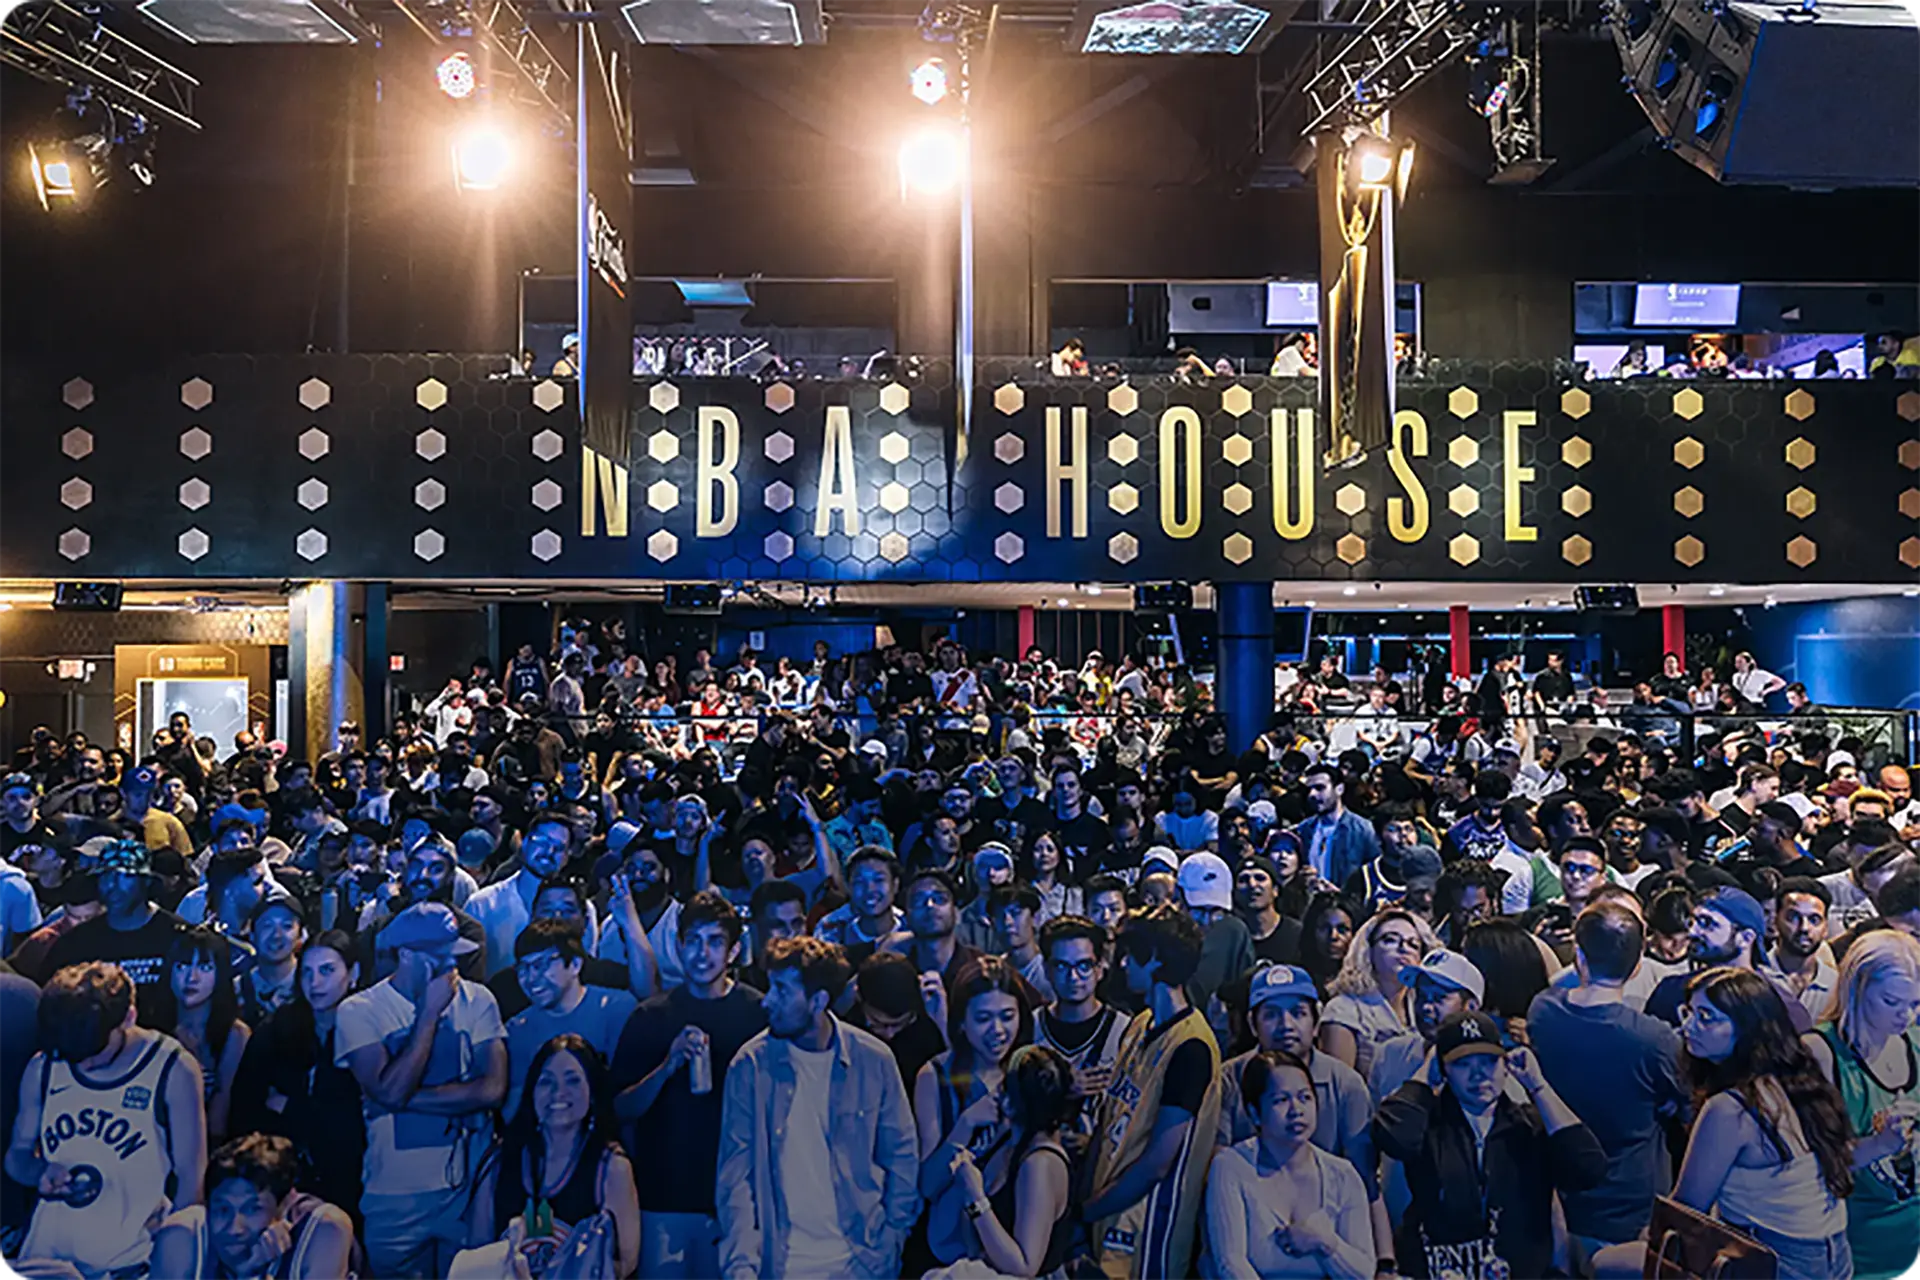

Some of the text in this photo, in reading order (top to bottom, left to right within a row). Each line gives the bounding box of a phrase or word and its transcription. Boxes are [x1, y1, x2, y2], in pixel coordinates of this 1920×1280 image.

[581, 405, 1538, 544] NBA HOUSE
[44, 1108, 148, 1160] BOSTON
